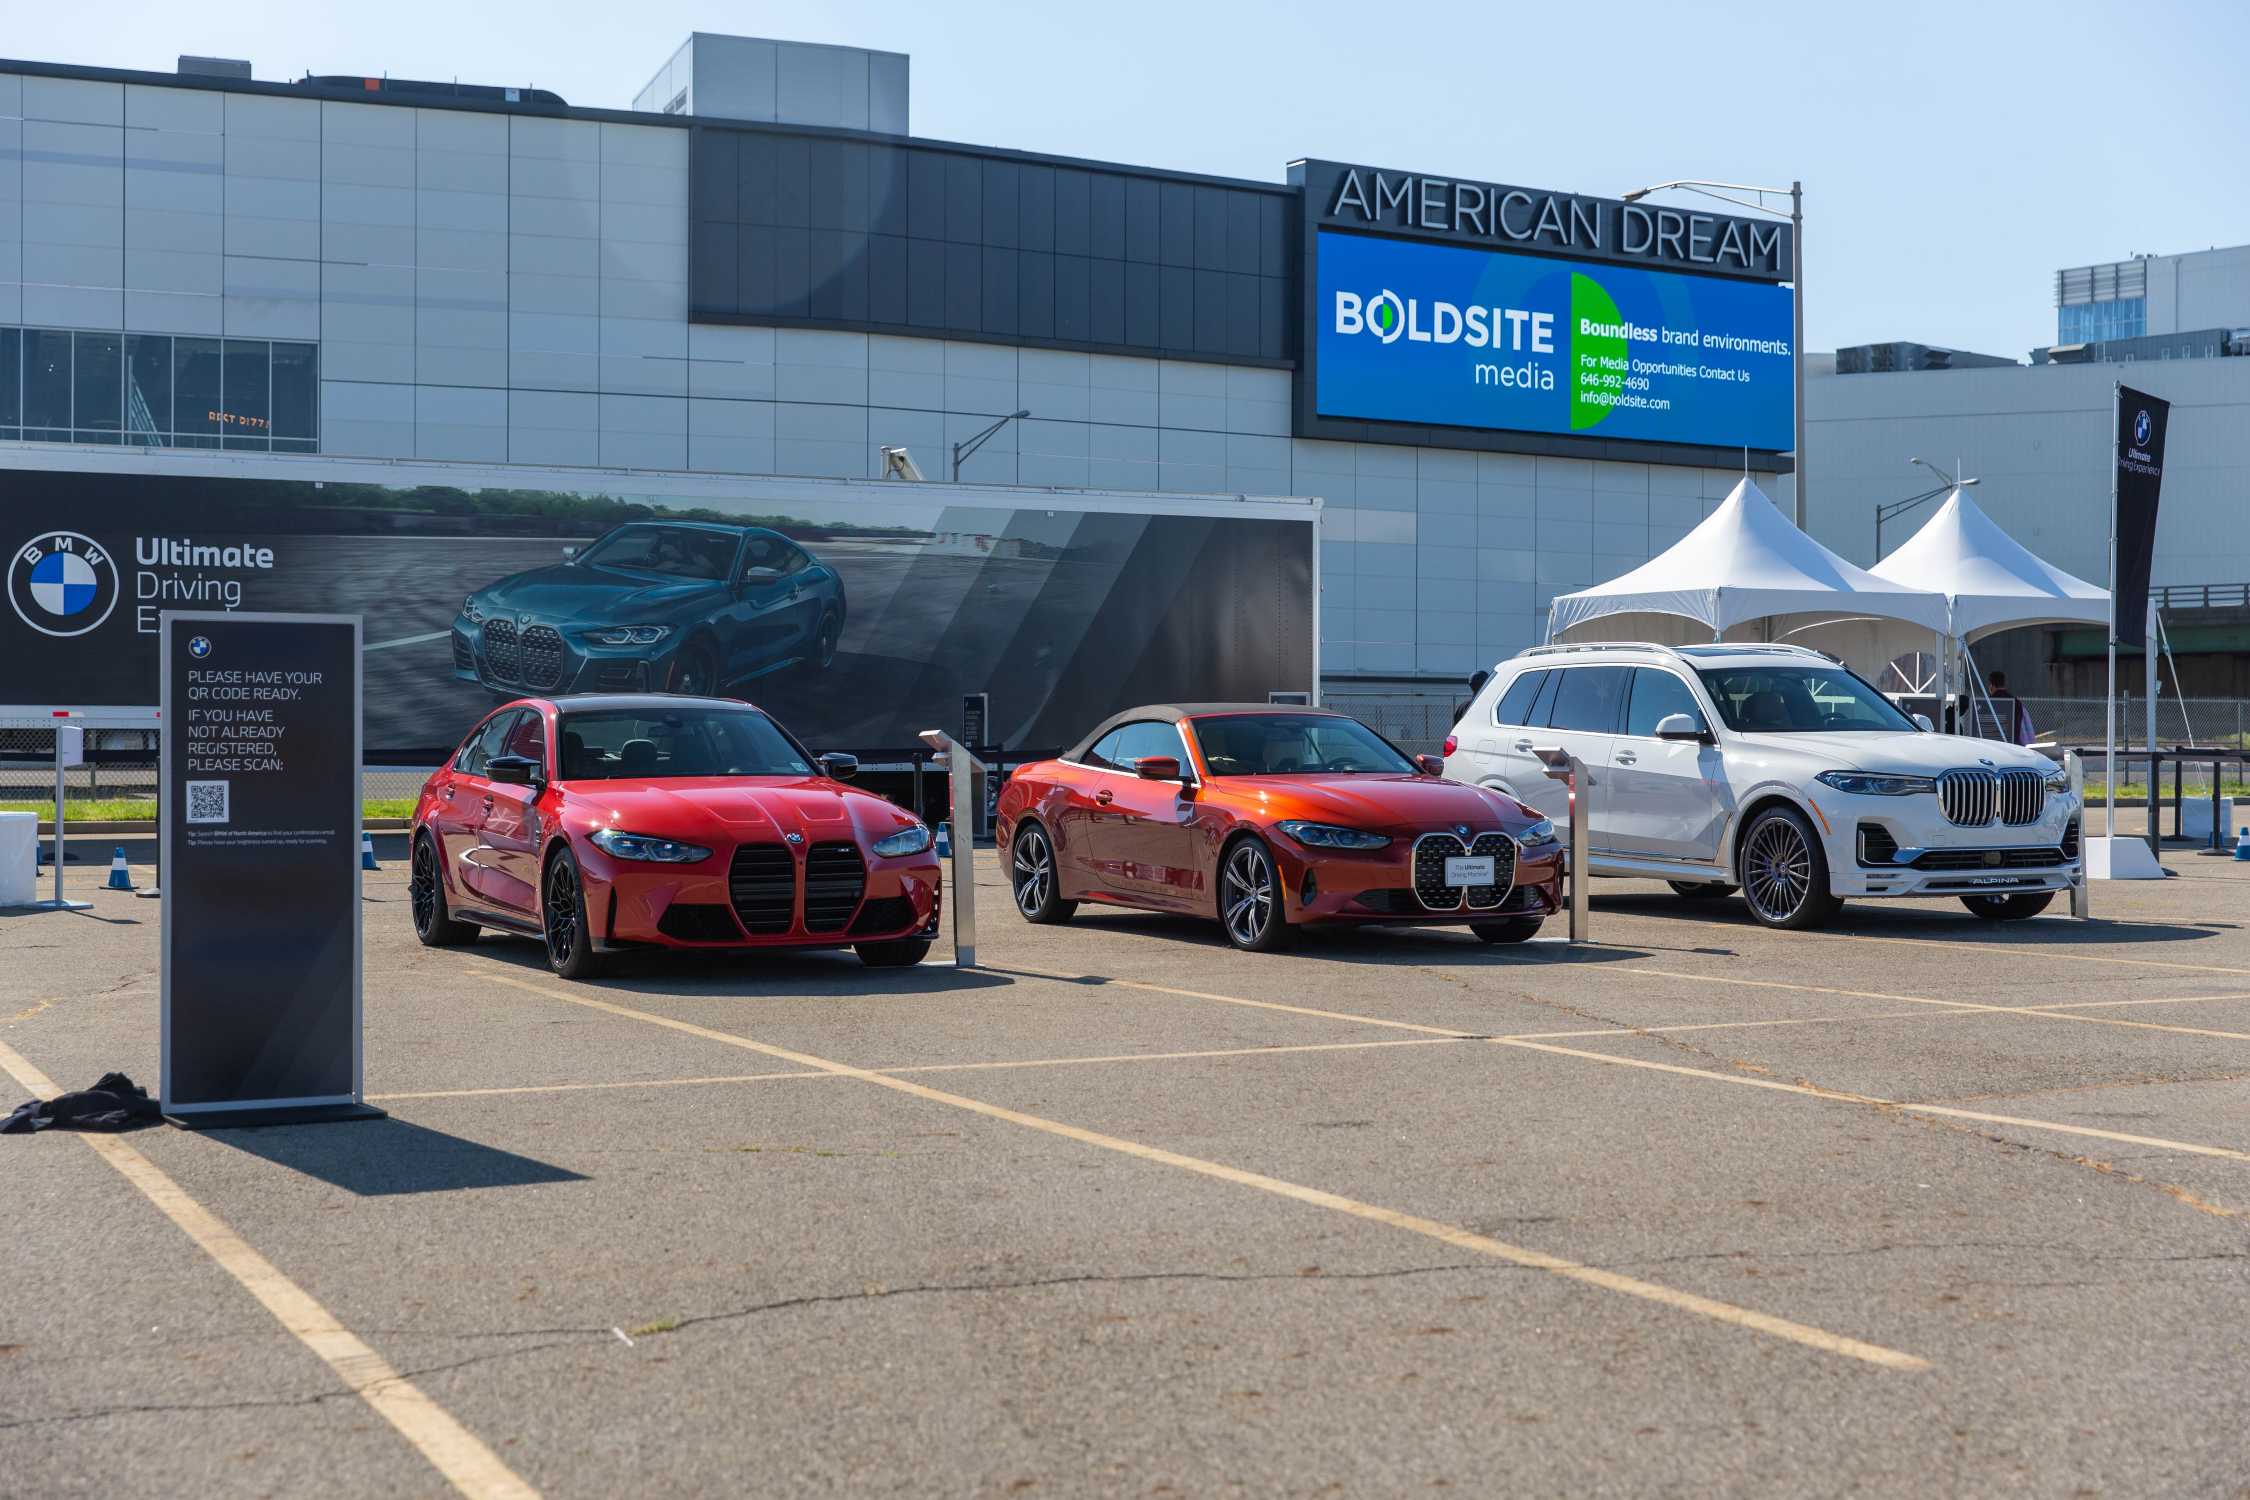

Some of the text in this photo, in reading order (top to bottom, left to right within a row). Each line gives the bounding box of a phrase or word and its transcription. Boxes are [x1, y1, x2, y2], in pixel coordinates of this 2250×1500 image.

[1334, 168, 1781, 271] AMERICAN DREAM
[1335, 288, 1555, 354] BOLDSITE
[1580, 318, 1792, 356] Boundless brand environments.
[1475, 360, 1555, 391] media
[1580, 354, 1751, 382] For Media Opportunities Contact Us
[1580, 372, 1650, 391] 646-992-4690
[1580, 390, 1671, 411] info@boldsite.com
[135, 536, 275, 569] Ultimate
[137, 571, 242, 608] Driving
[188, 670, 323, 685] PLEASE HAVE YOUR
[188, 686, 302, 701] QR CODE READY.
[188, 709, 274, 722] IF YOU HAVE
[188, 726, 286, 739] NOT ALREADY
[188, 742, 277, 756] REGISTERED,
[188, 758, 284, 772] PLEASE SCAN:
